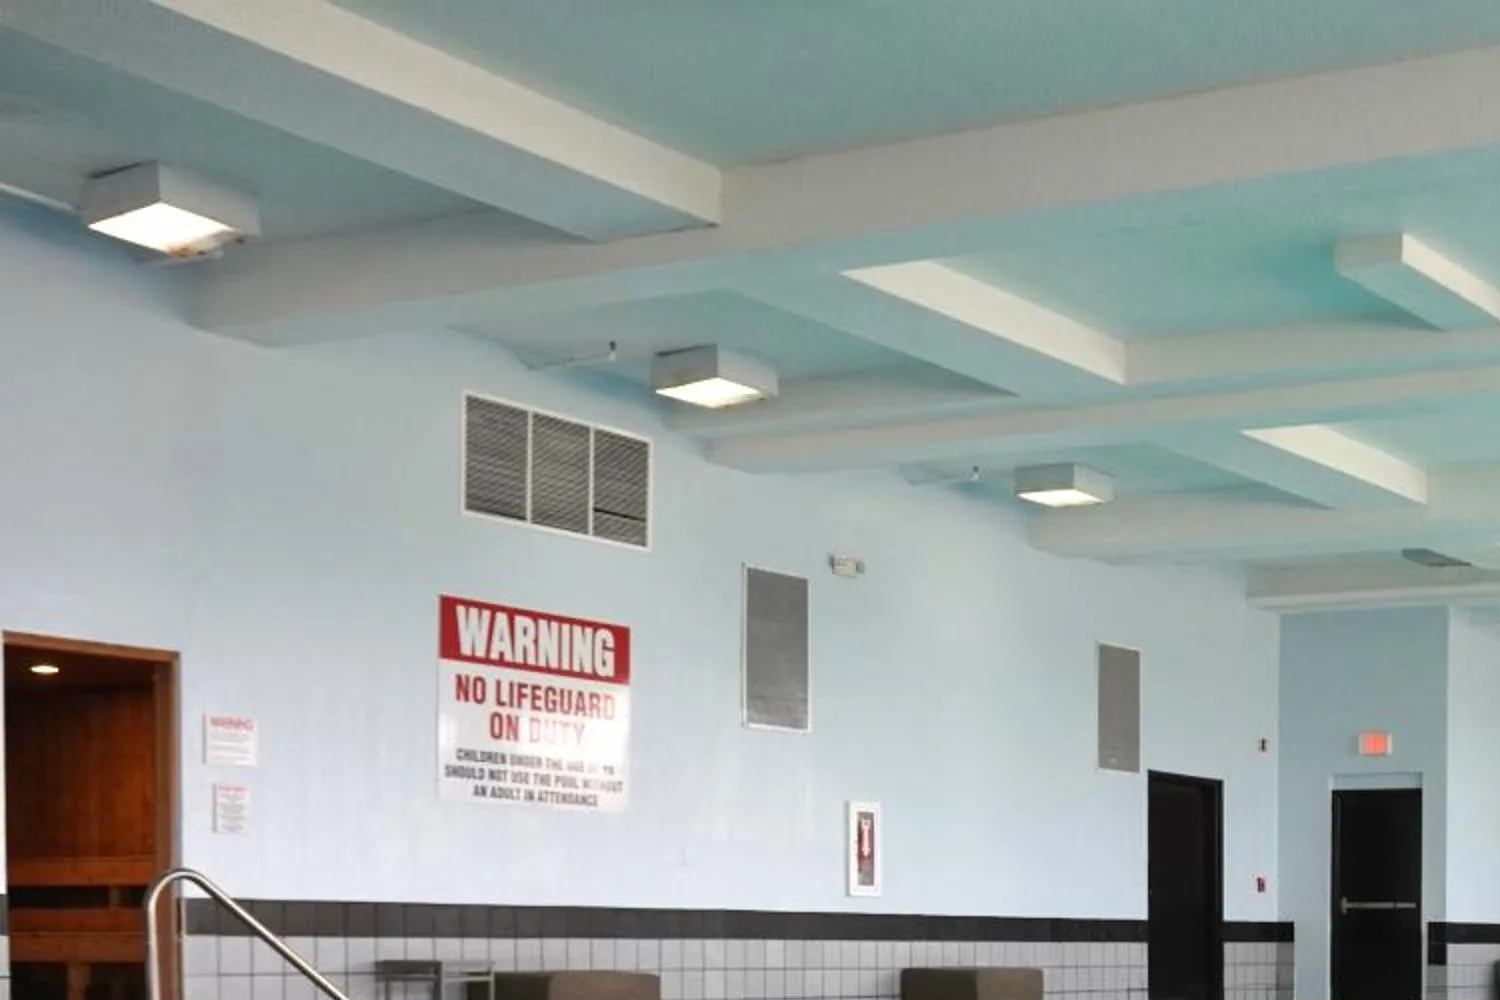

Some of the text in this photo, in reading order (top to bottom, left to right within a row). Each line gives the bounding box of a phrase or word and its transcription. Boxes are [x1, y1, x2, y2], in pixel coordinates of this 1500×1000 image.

[456, 605, 615, 678] WARNING
[455, 674, 616, 720] NO LIFEGUARD
[490, 712, 586, 747] ON DUTY
[456, 748, 507, 765] CHILDREN
[444, 764, 485, 781] SHOULD
[488, 769, 507, 782] NOT
[473, 785, 487, 797] AN
[490, 786, 521, 801] ADULT
[537, 791, 598, 807] ATTENDANCE
